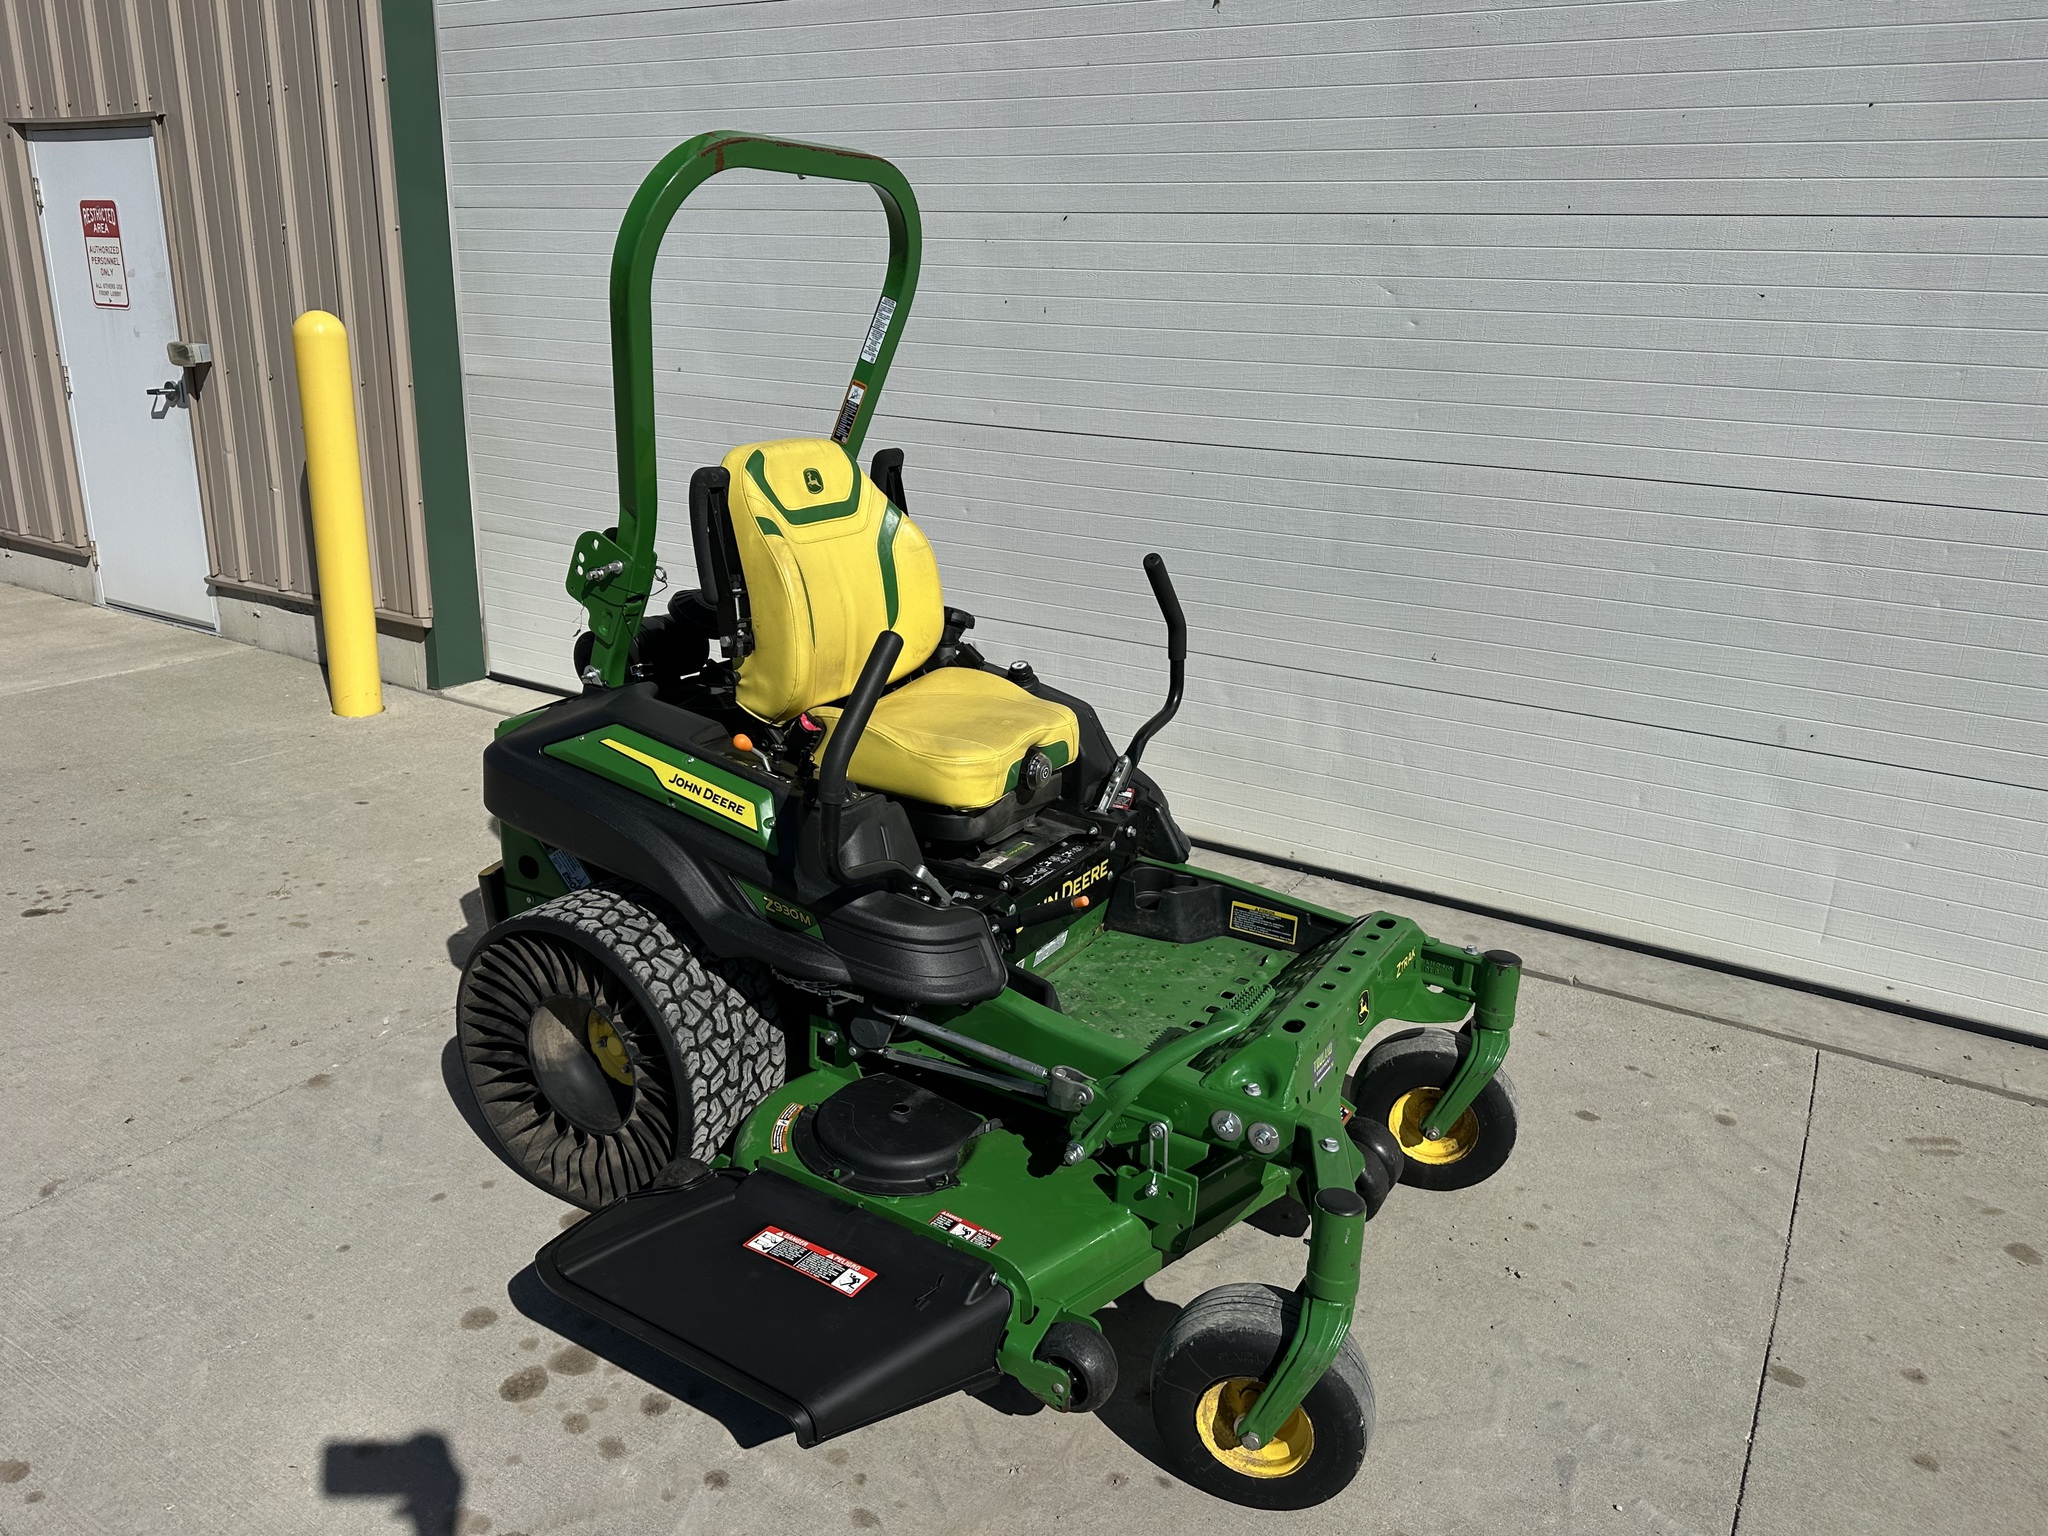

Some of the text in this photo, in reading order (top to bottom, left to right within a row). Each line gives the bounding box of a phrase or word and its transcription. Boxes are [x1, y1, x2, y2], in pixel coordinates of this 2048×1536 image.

[82, 207, 116, 226] RESTRICTED
[93, 222, 110, 234] AREA
[89, 245, 119, 255] AUTHORIZED
[91, 256, 120, 266] PERSONNEL
[100, 267, 114, 277] ONLY
[668, 773, 746, 816] JOHN DEERE
[1062, 858, 1110, 899] DEERE
[763, 896, 812, 926] Z930M
[783, 1233, 809, 1247] DANGER
[833, 1255, 861, 1271] PELIGRO
